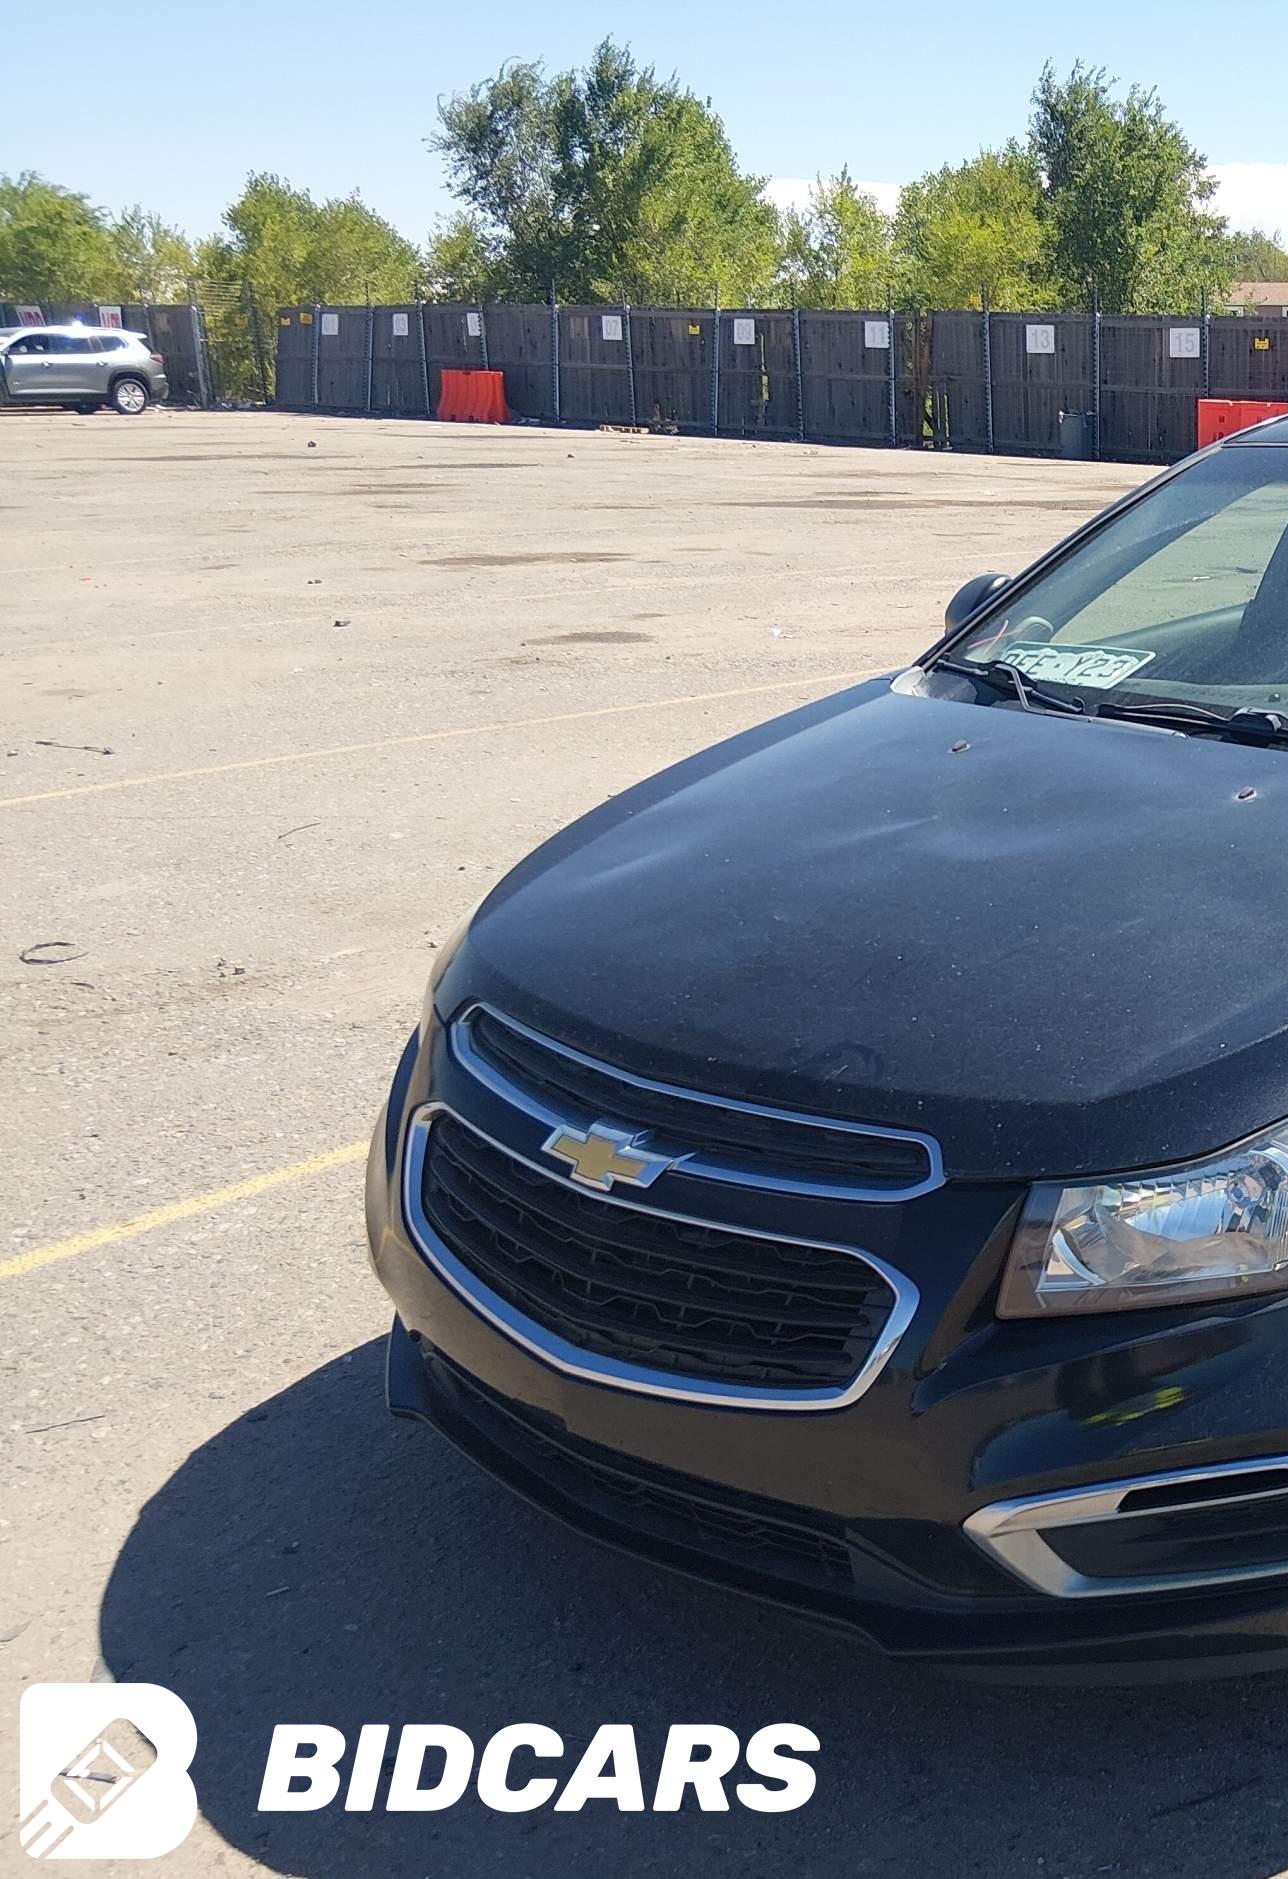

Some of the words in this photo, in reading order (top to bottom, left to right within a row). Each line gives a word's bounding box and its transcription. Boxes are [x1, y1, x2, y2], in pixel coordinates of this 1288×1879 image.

[606, 320, 617, 336] 07
[738, 323, 751, 340] 09
[870, 326, 887, 344] 11
[1032, 329, 1050, 349] 13
[1175, 333, 1194, 352] 15
